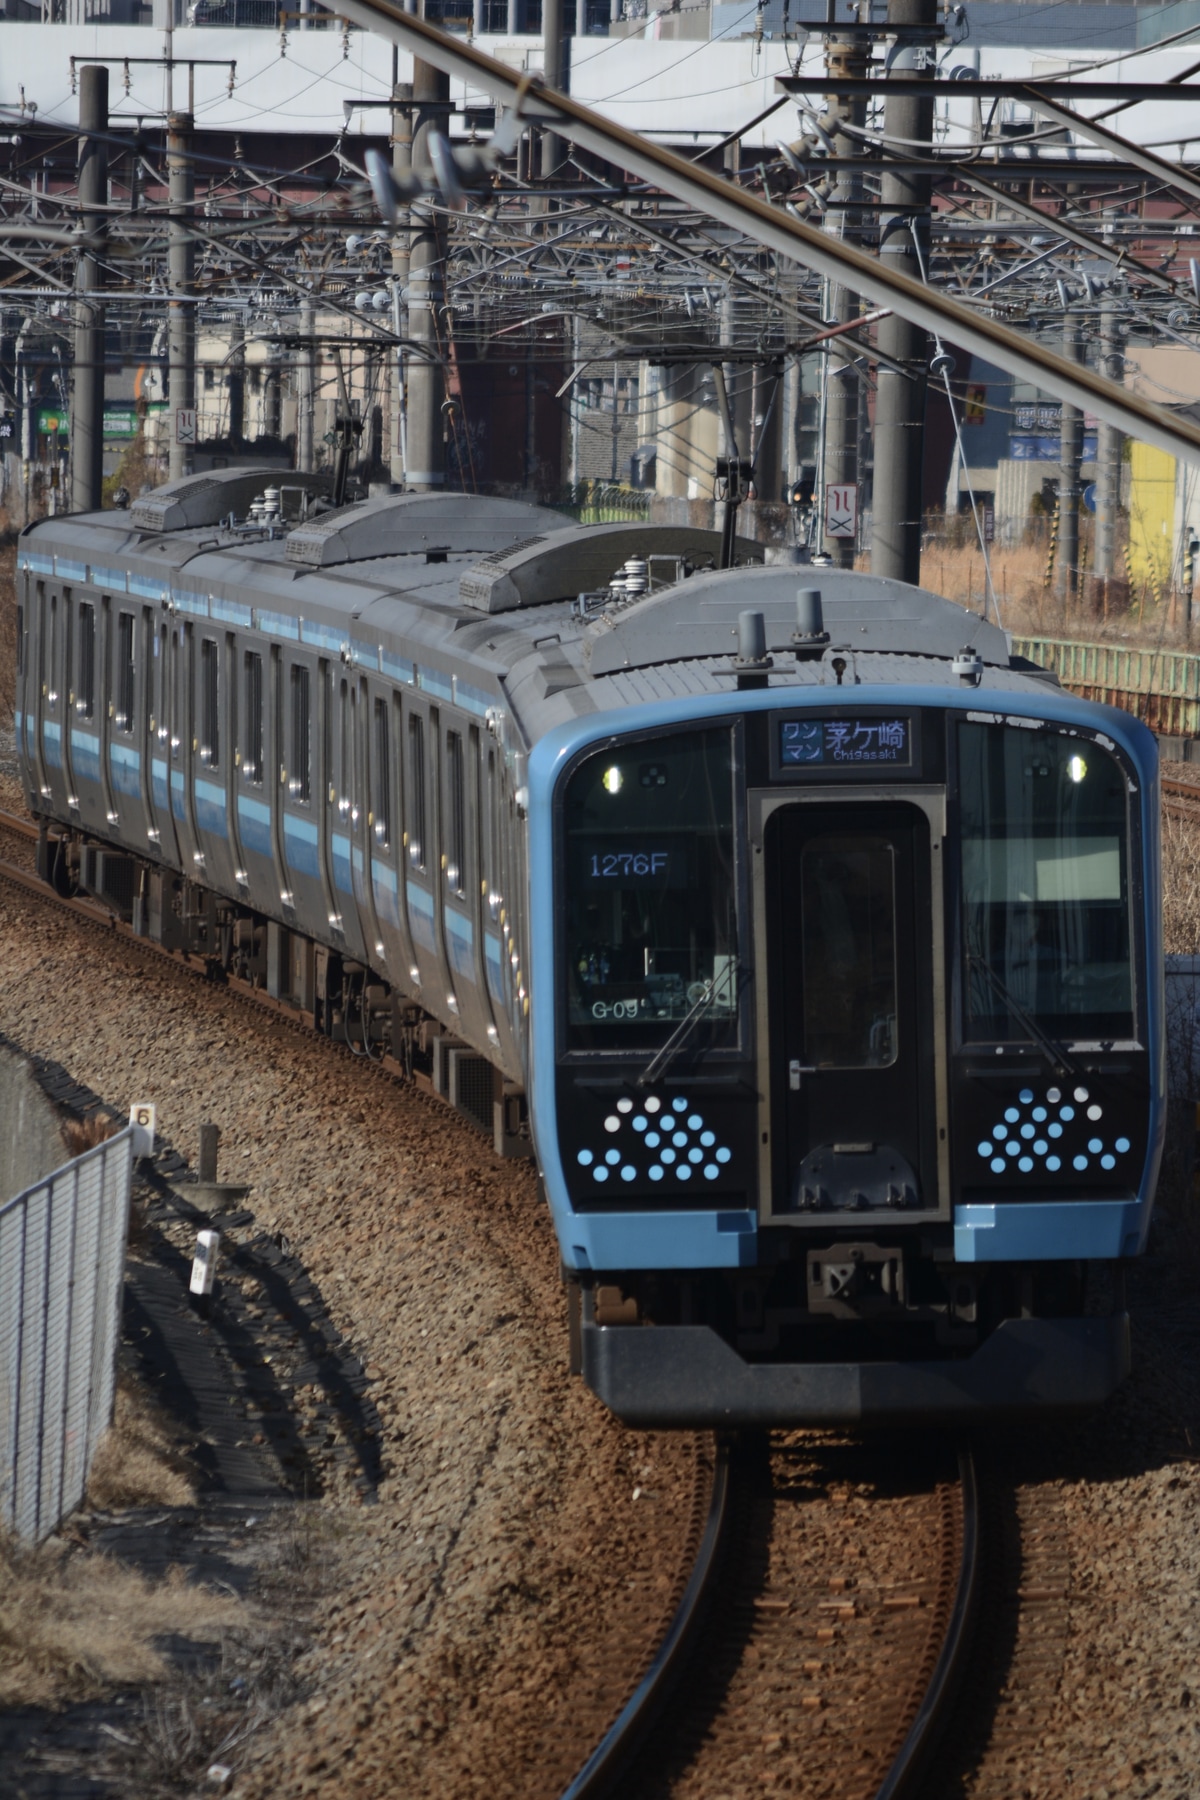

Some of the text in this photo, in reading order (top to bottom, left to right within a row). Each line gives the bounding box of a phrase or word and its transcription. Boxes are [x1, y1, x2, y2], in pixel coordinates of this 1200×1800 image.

[1013, 443, 1034, 457] 2F
[784, 723, 817, 739] ワン
[786, 744, 820, 759] マン
[833, 749, 897, 760] Chigasaki
[591, 853, 668, 876] 1276F
[137, 1109, 149, 1126] 6
